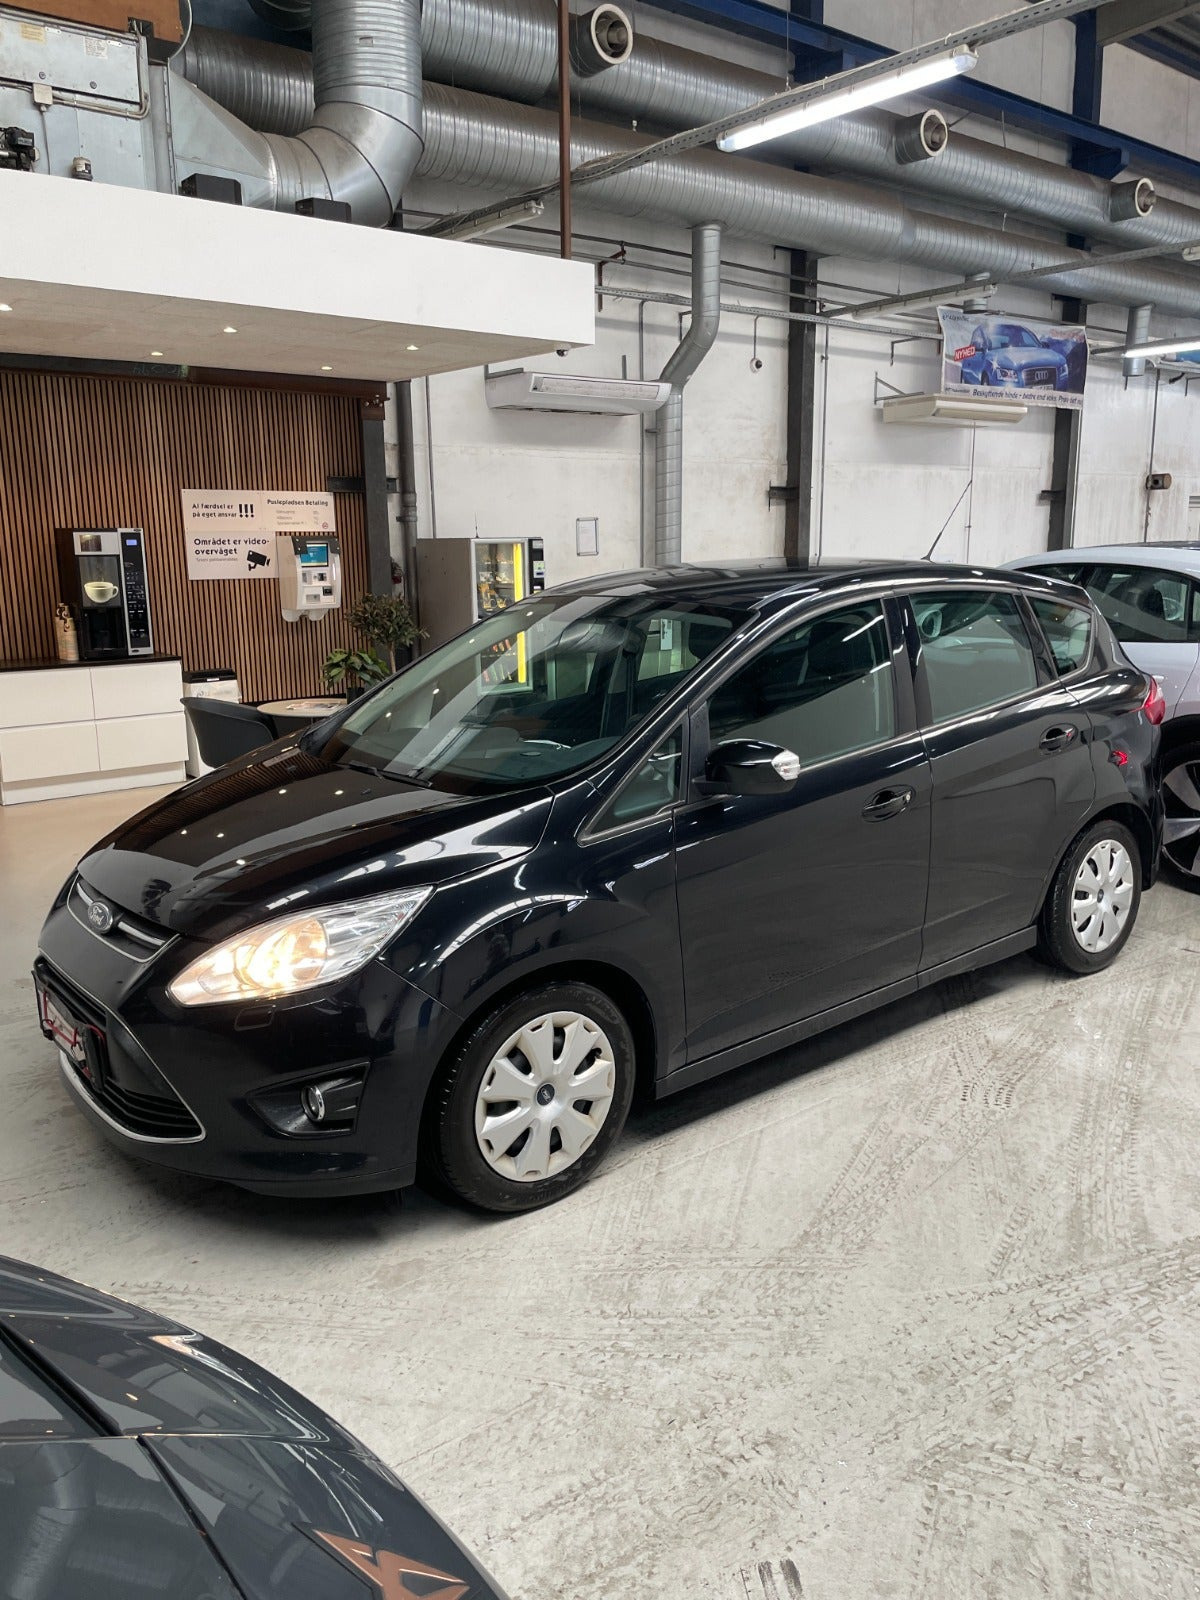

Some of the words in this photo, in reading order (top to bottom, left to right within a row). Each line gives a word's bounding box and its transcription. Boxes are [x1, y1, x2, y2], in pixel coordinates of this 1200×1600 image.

[954, 346, 976, 360] NYHED
[193, 537, 231, 546] Området
[243, 537, 270, 545] video-
[194, 548, 238, 556] overvåget
